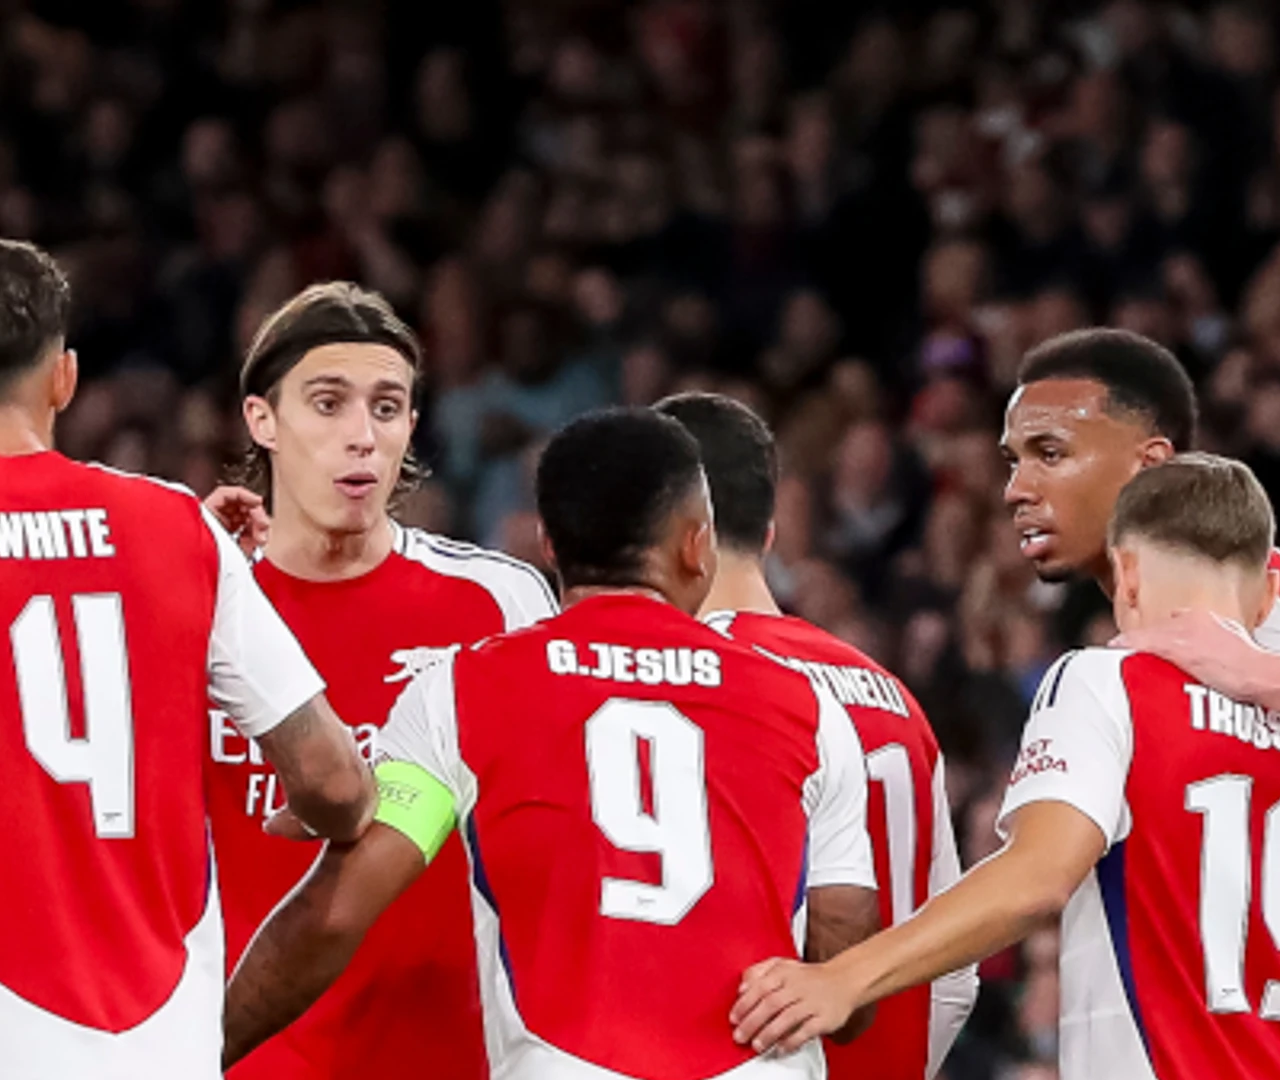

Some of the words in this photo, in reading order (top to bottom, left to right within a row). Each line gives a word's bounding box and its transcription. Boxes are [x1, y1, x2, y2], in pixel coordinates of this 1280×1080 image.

[8, 590, 136, 839] 4
[545, 639, 721, 688] G.JESUS
[245, 773, 286, 818] FL
[584, 697, 715, 926] 9
